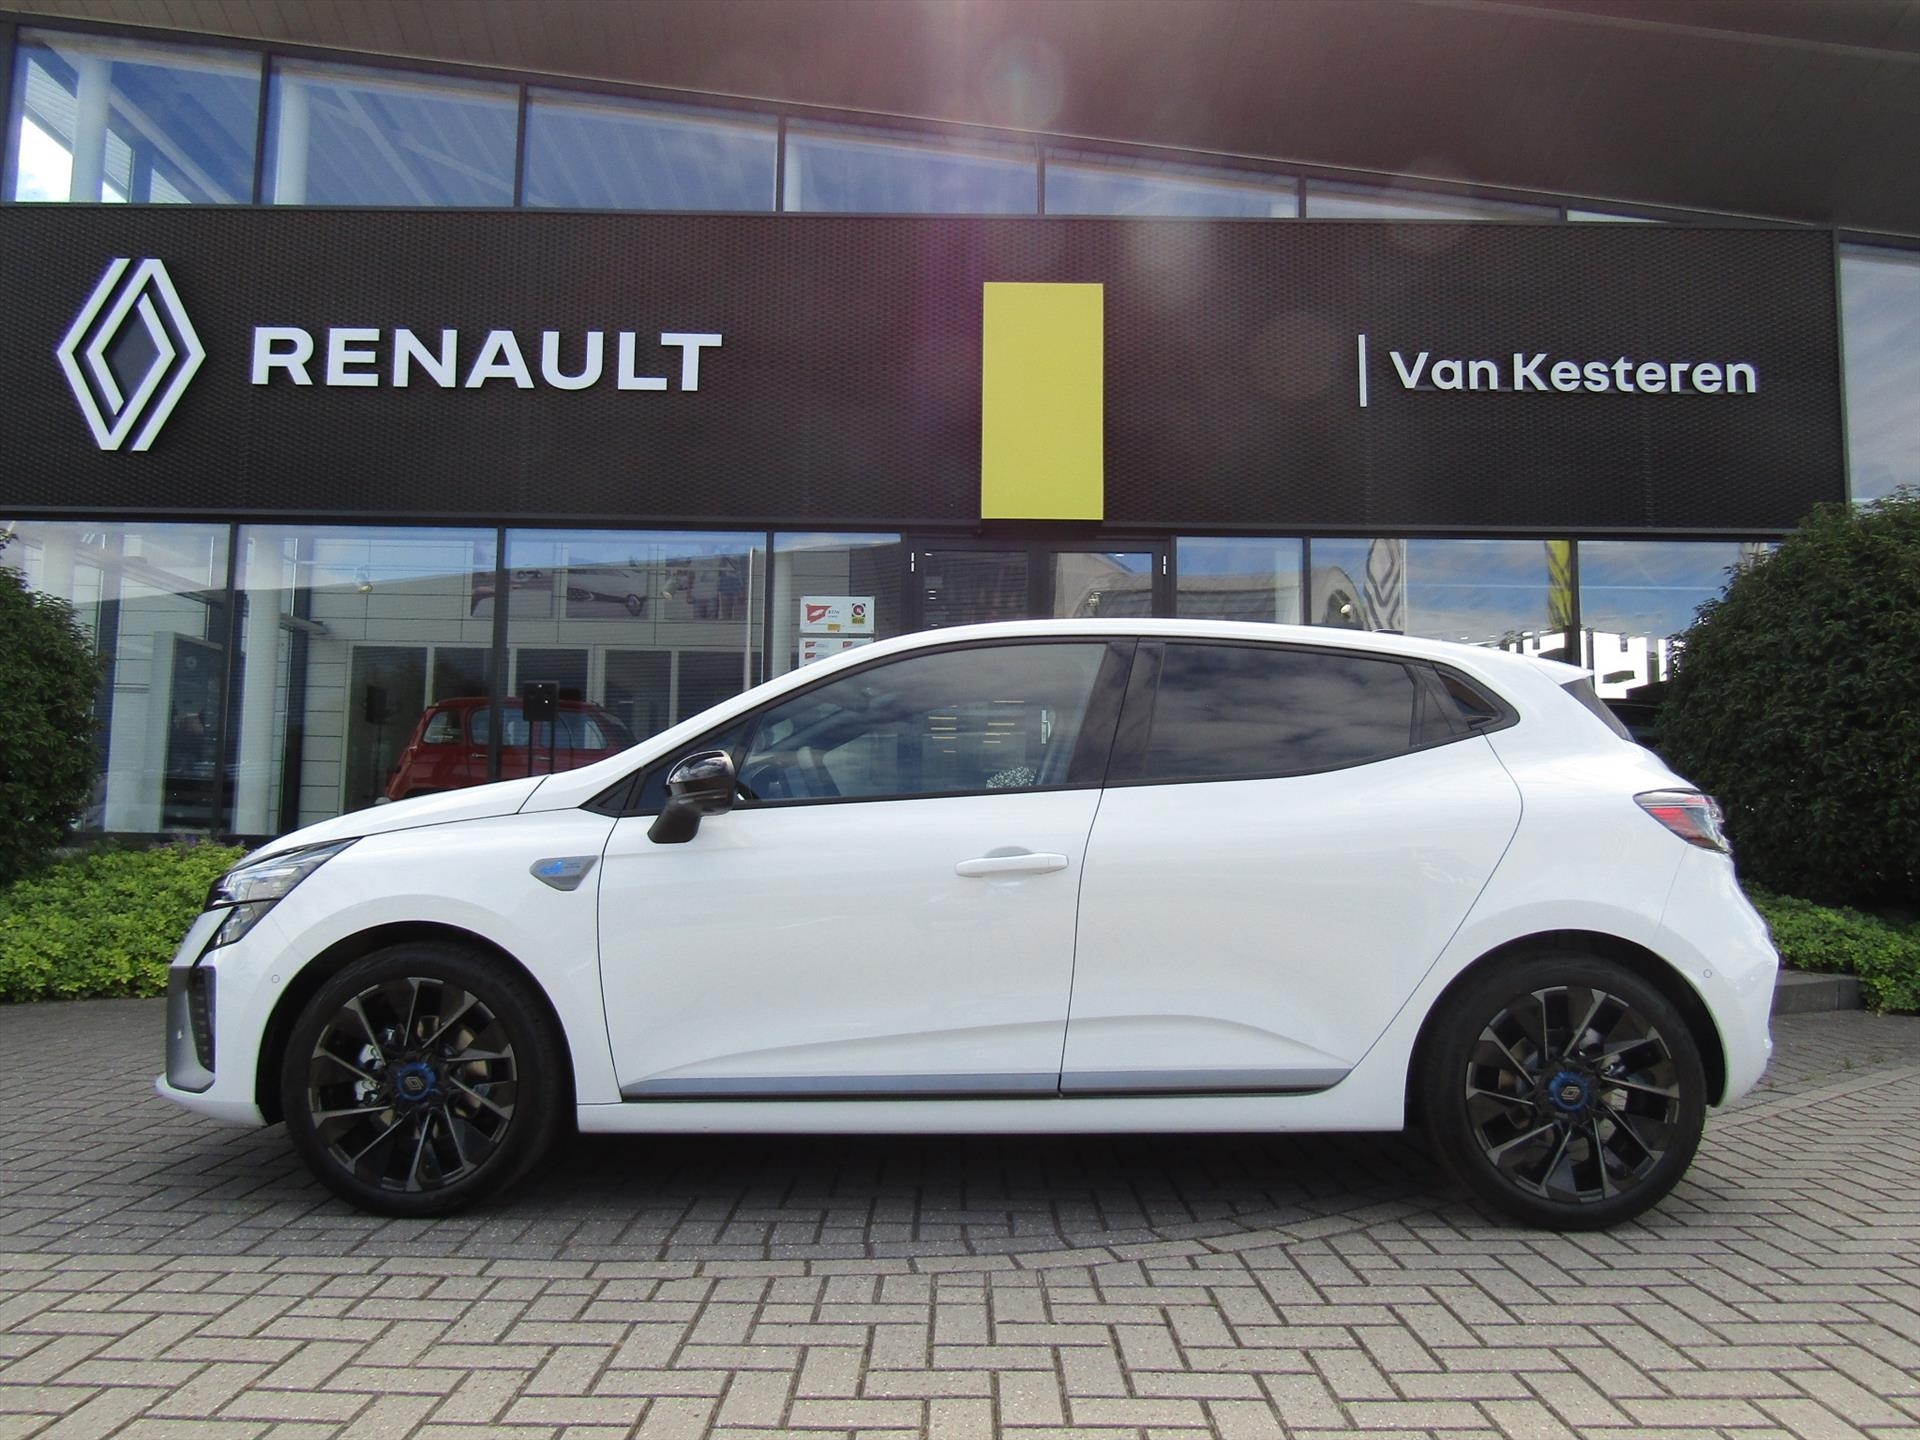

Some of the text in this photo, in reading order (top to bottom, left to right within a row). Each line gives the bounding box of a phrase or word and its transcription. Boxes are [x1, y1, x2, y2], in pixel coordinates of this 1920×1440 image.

[251, 326, 723, 392] RENAULT
[1389, 351, 1757, 393] Van Kesteren
